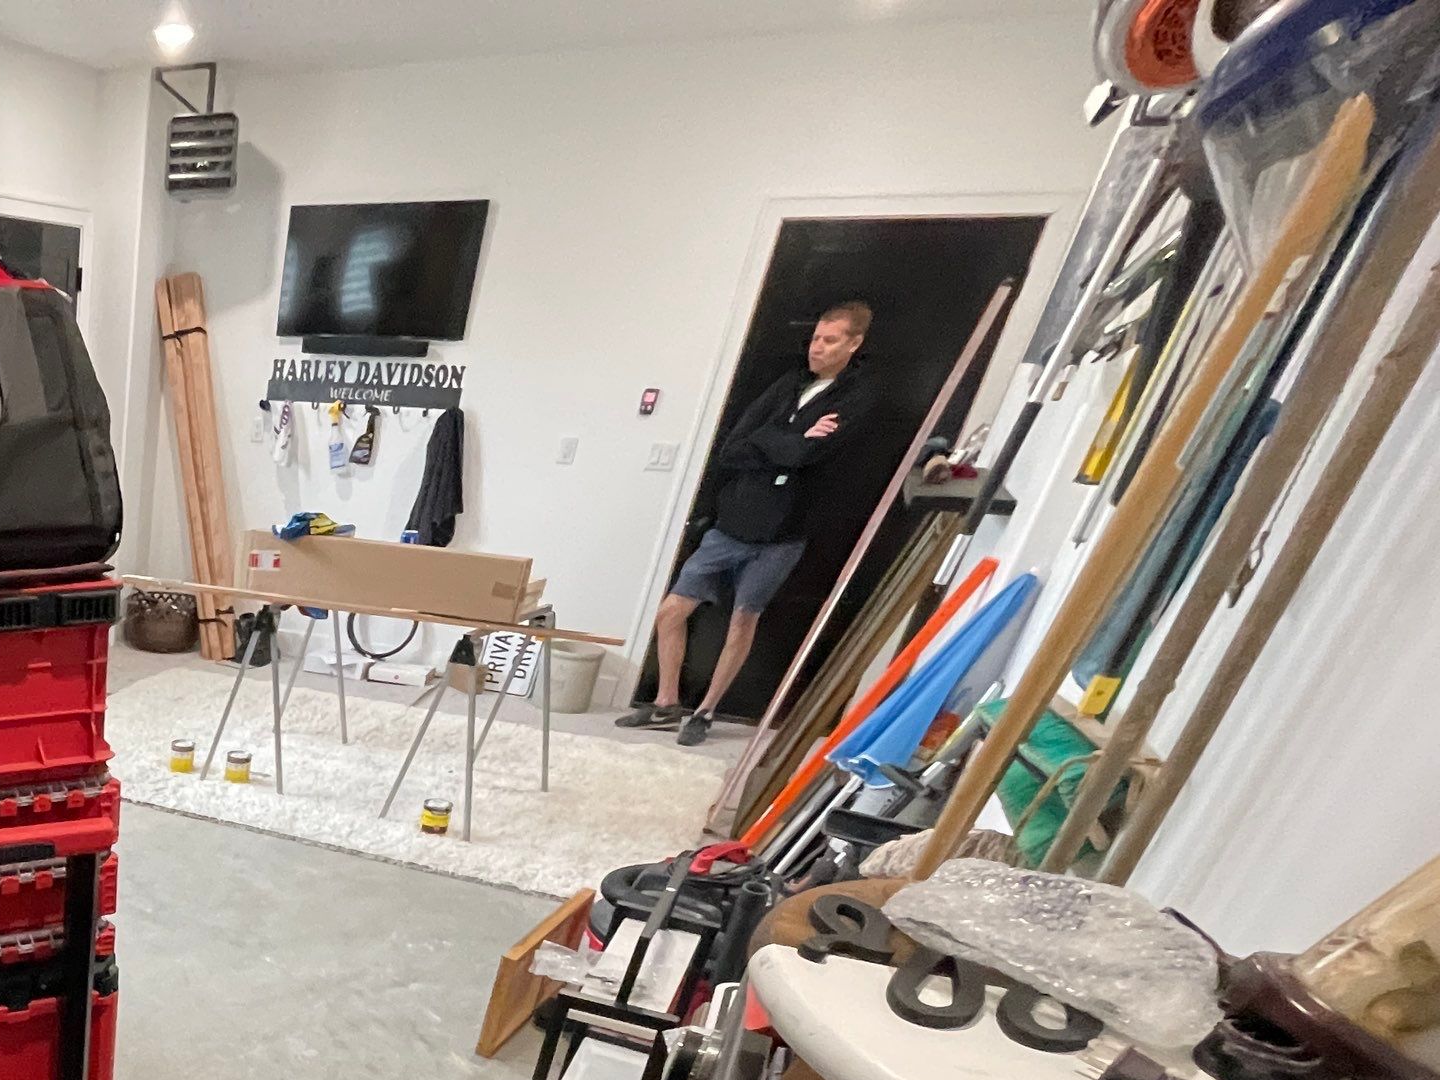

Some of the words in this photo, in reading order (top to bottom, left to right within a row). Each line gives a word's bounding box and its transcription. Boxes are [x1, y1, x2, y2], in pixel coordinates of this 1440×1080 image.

[271, 359, 351, 384] HARLEY
[356, 361, 466, 389] DAVIDSON
[329, 387, 392, 402] WELCOME
